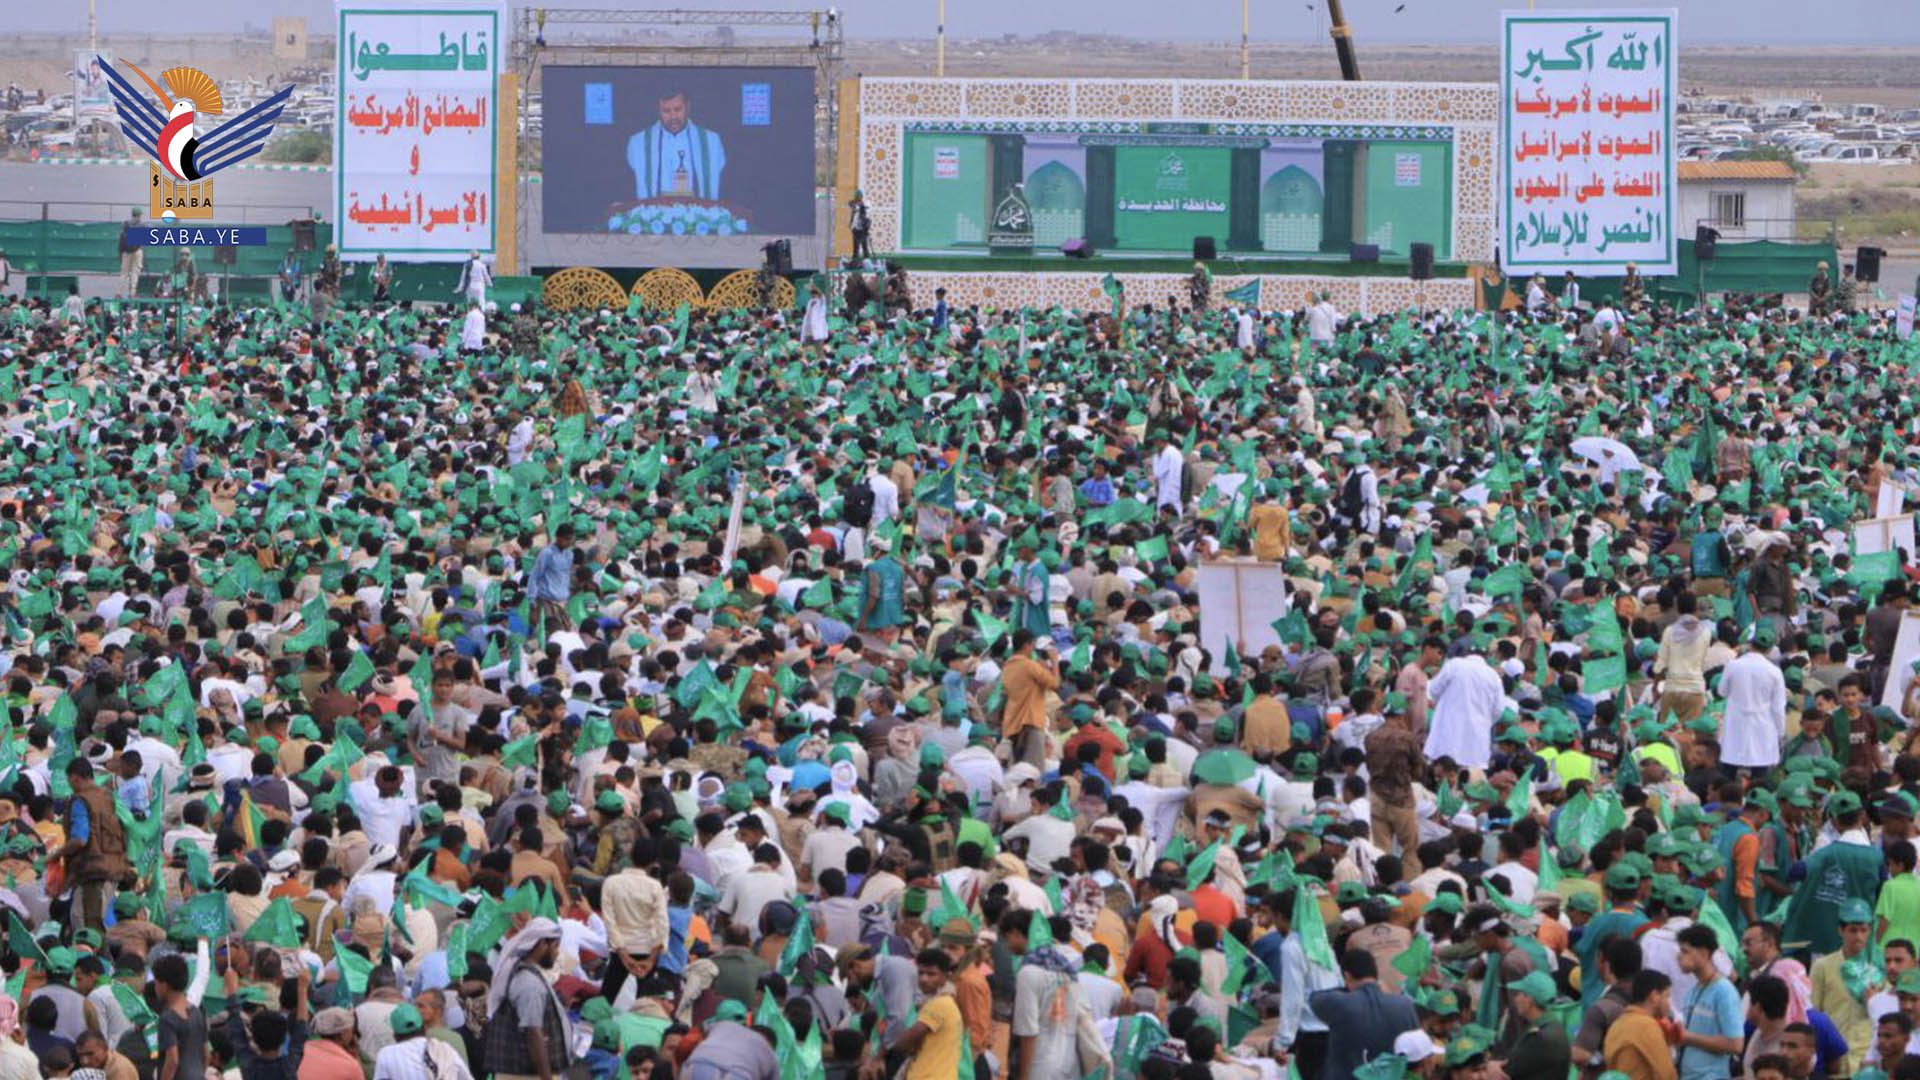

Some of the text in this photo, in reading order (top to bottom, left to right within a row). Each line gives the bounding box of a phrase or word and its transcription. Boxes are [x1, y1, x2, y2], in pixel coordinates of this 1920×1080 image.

[349, 31, 488, 81] قاطعوا
[1514, 25, 1662, 84] الله أكبر
[348, 89, 487, 135] البضائع الأمريكية
[1515, 82, 1660, 120] الموت لأمريكا
[409, 144, 420, 176] و
[1515, 130, 1660, 163] الموت لإسرائيل
[1118, 196, 1226, 212] محافظة الحديدة
[1514, 171, 1661, 204] اللعنة على اليهود
[348, 191, 487, 233] الإسرائيلية
[1515, 206, 1661, 256] النصر للإسلام
